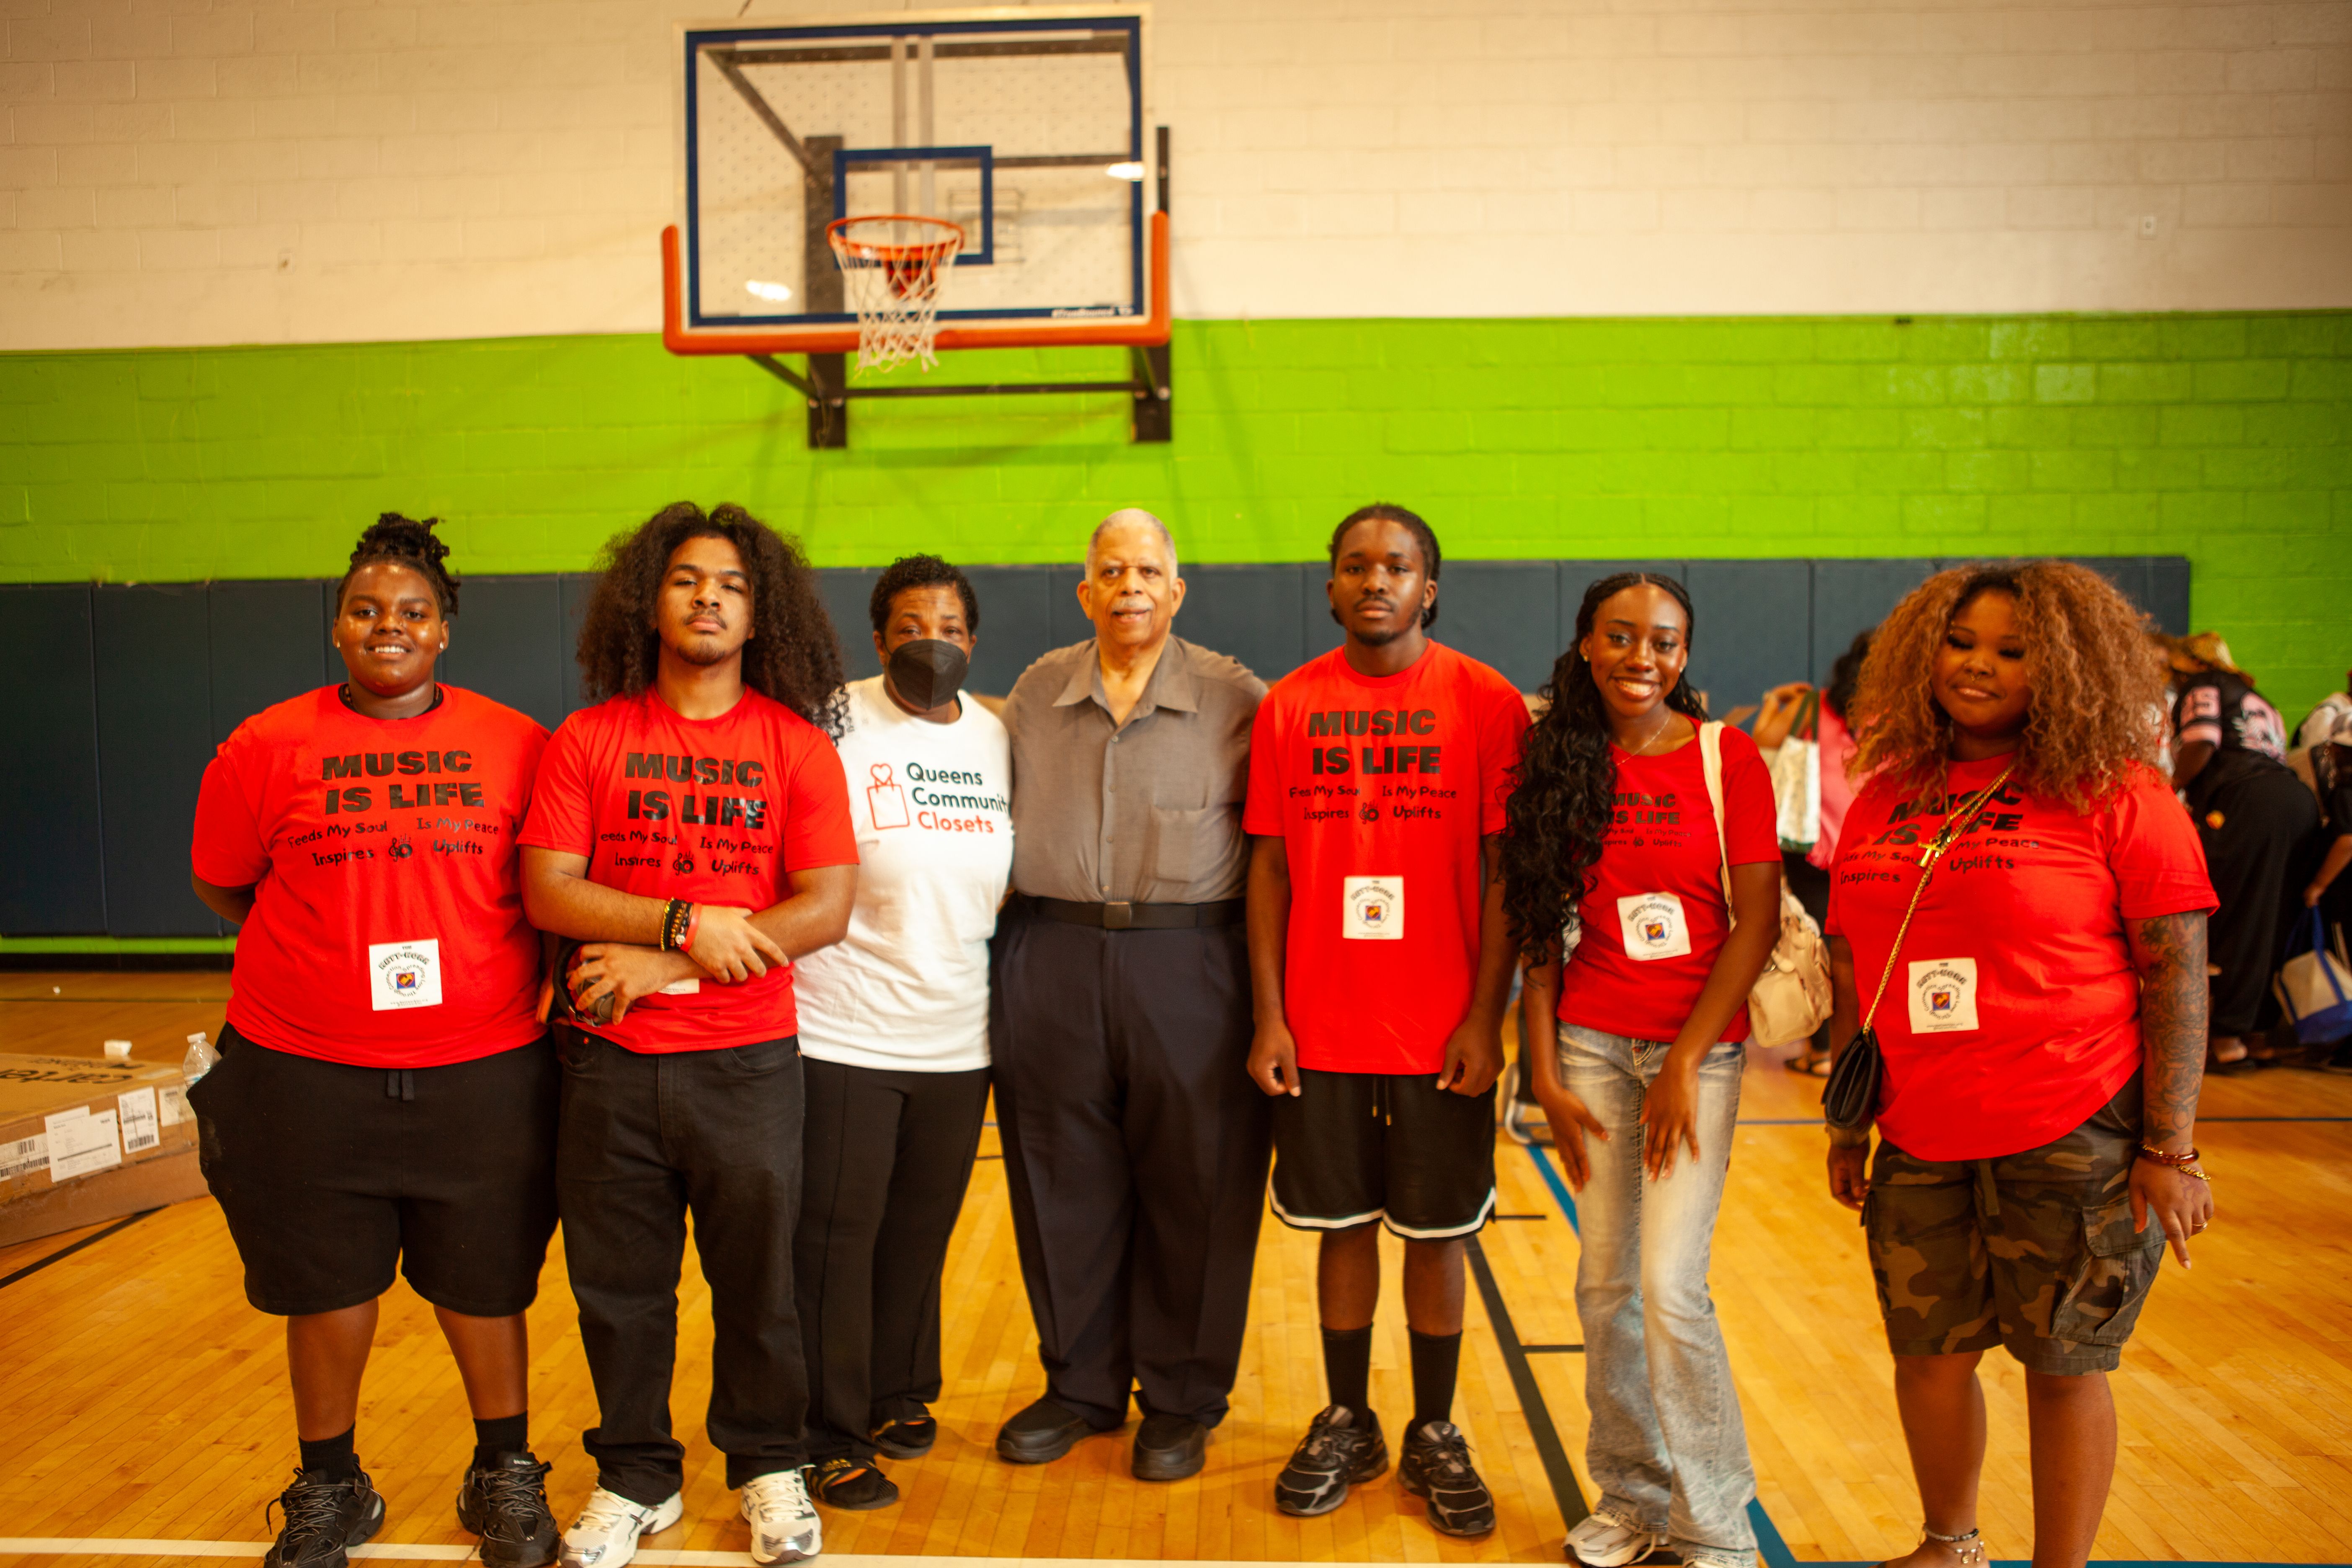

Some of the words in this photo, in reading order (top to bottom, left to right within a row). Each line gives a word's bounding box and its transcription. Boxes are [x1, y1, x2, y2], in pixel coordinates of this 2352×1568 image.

[1308, 709, 1436, 737] MUSIC
[322, 750, 472, 780] MUSIC
[625, 753, 763, 787] MUSIC
[906, 762, 983, 786] Queens
[1312, 747, 1350, 775] IS
[1362, 746, 1441, 775] LIFE
[325, 787, 372, 815] IS
[389, 782, 485, 810] LIFE
[912, 787, 1008, 814] Communit
[1314, 785, 1333, 798] My
[1382, 785, 1393, 797] Is
[1396, 786, 1416, 799] My
[1420, 786, 1457, 798] Peace
[627, 790, 670, 821] IS
[681, 795, 767, 830] LIFE
[918, 812, 994, 833] Closets
[1304, 807, 1349, 823] Inspires
[1393, 805, 1441, 821] Uplifts
[1635, 811, 1680, 825] LIFE
[288, 829, 323, 848] Feeds
[327, 824, 350, 838] My
[355, 820, 387, 833] Soul
[417, 818, 431, 830] Is
[437, 818, 461, 833] My
[464, 819, 499, 835] Peace
[601, 831, 626, 842] eeds
[629, 830, 648, 844] My
[651, 832, 677, 845] Soul
[700, 837, 712, 849] Is
[717, 838, 738, 853] My
[741, 841, 774, 854] Peace
[1872, 824, 1921, 845] IS
[312, 848, 374, 867] Inspires
[433, 838, 483, 856] Uplifts
[1890, 852, 1922, 866] Sou
[1986, 838, 2039, 849] Peace
[712, 859, 759, 876] Uplifts
[1841, 869, 1901, 885] Inspires
[1950, 855, 2014, 874] Uplifts
